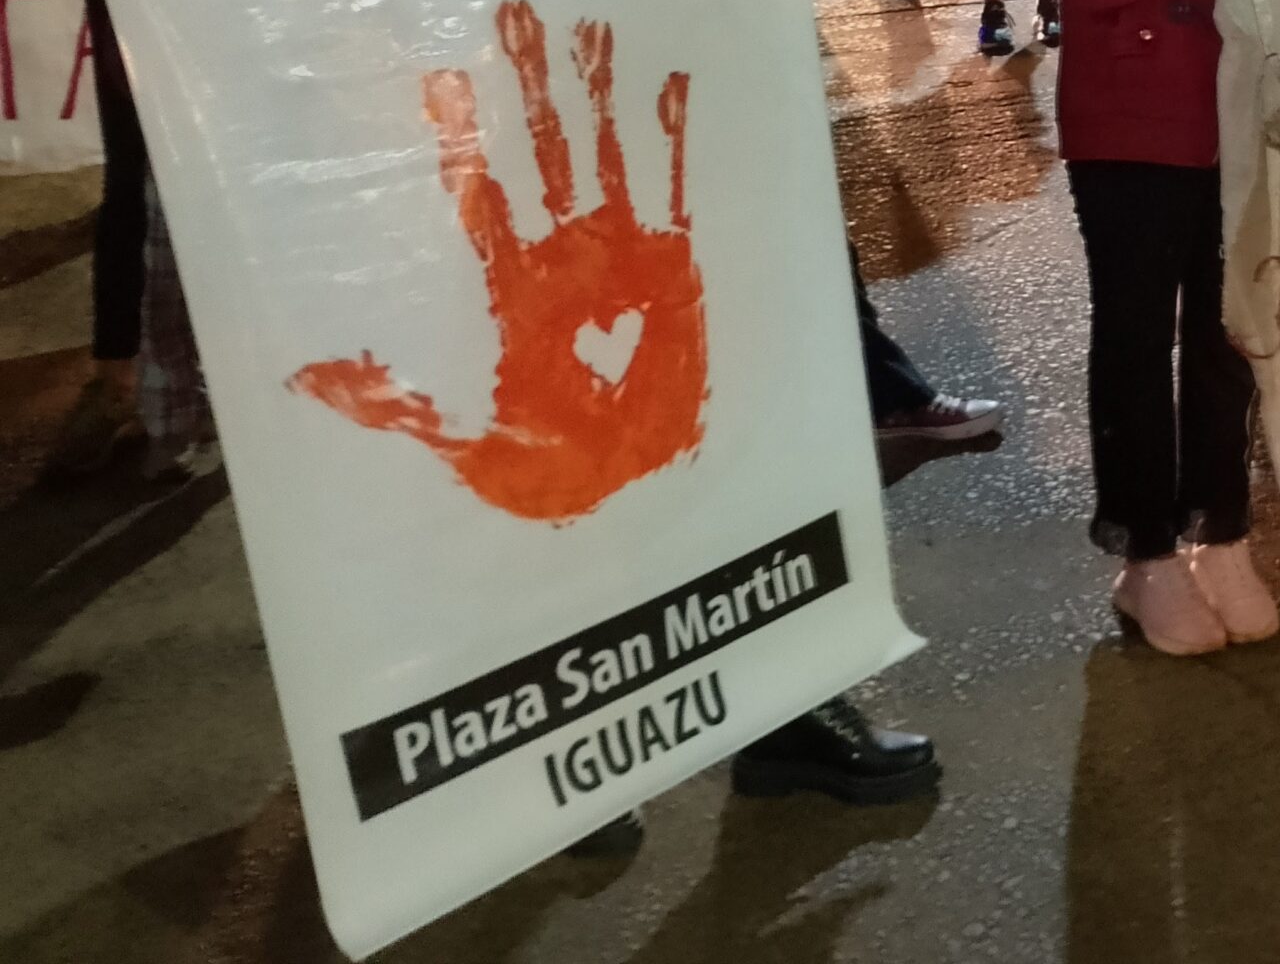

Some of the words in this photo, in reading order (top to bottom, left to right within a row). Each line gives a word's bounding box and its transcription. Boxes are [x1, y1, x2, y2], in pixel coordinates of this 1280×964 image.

[392, 682, 549, 786] Plaza
[555, 633, 655, 710] San
[664, 550, 816, 660] Martín
[543, 670, 729, 807] IGUAZU
